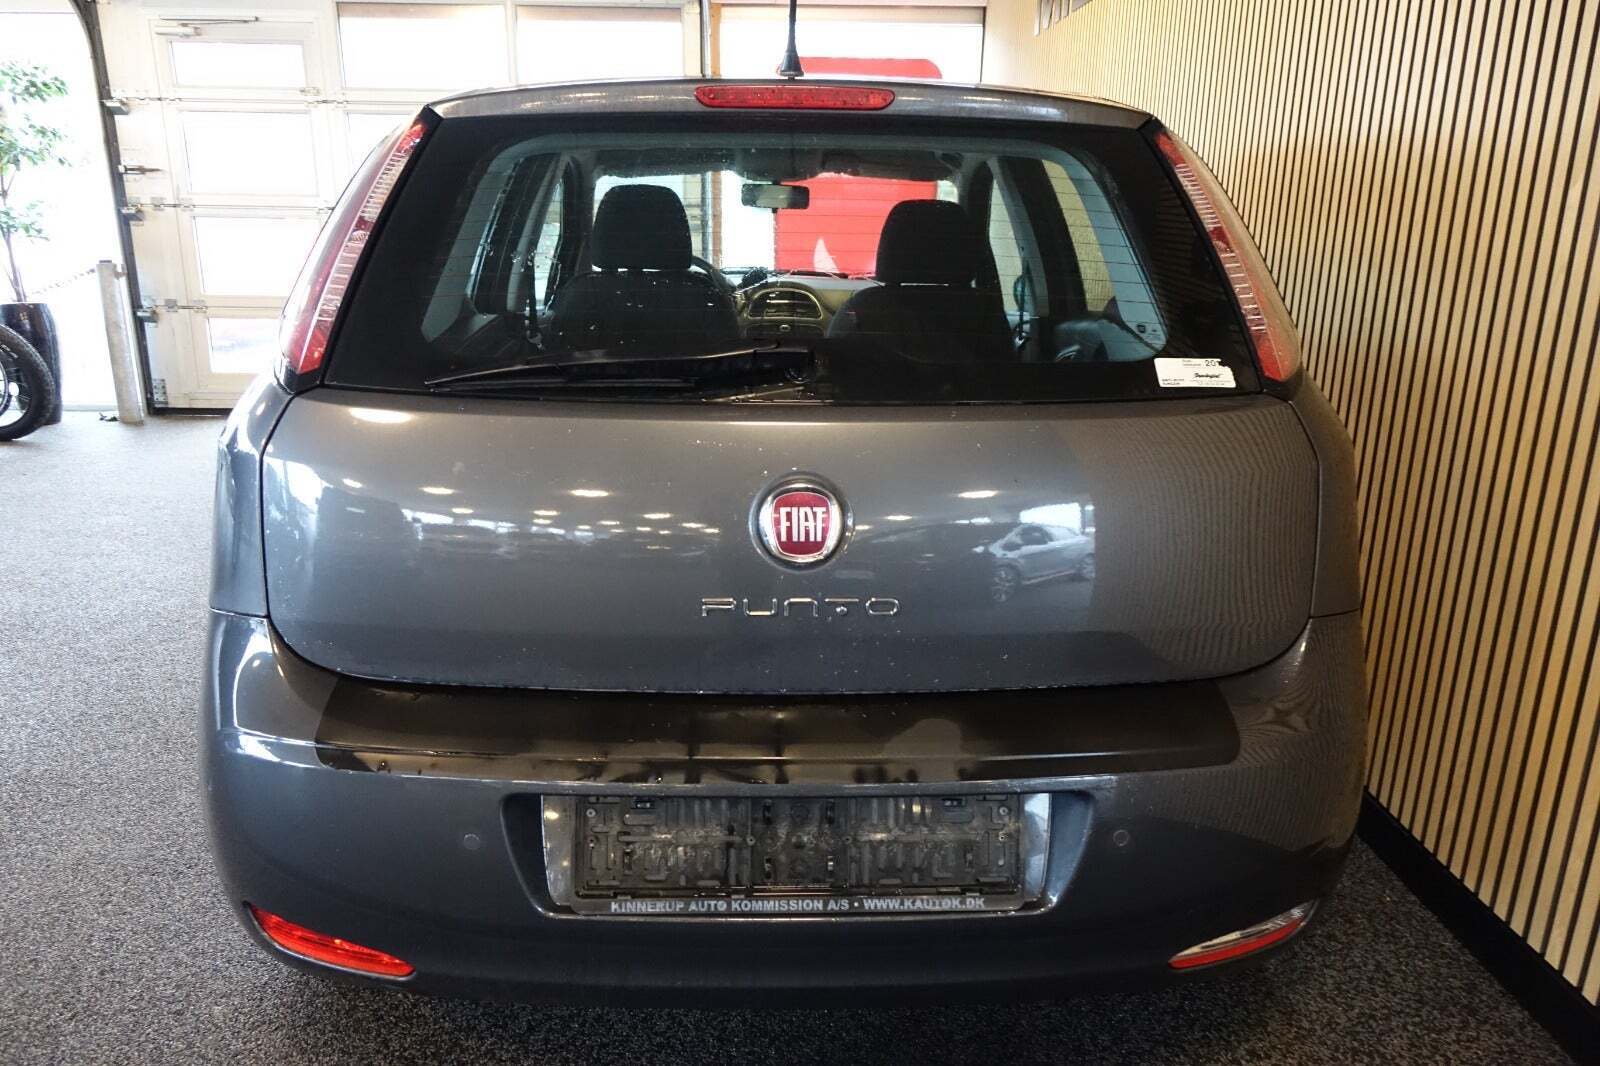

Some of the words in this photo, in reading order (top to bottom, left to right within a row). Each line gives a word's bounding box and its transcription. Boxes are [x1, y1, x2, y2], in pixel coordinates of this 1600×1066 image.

[779, 506, 827, 543] FIAT
[701, 597, 901, 617] PUNTO
[610, 900, 685, 913] KINNERUP
[688, 900, 727, 912] AUTO
[731, 898, 823, 912] KOMMISSION
[827, 899, 850, 911] A/S
[863, 897, 985, 911] WWW.KAUTOK.DK
